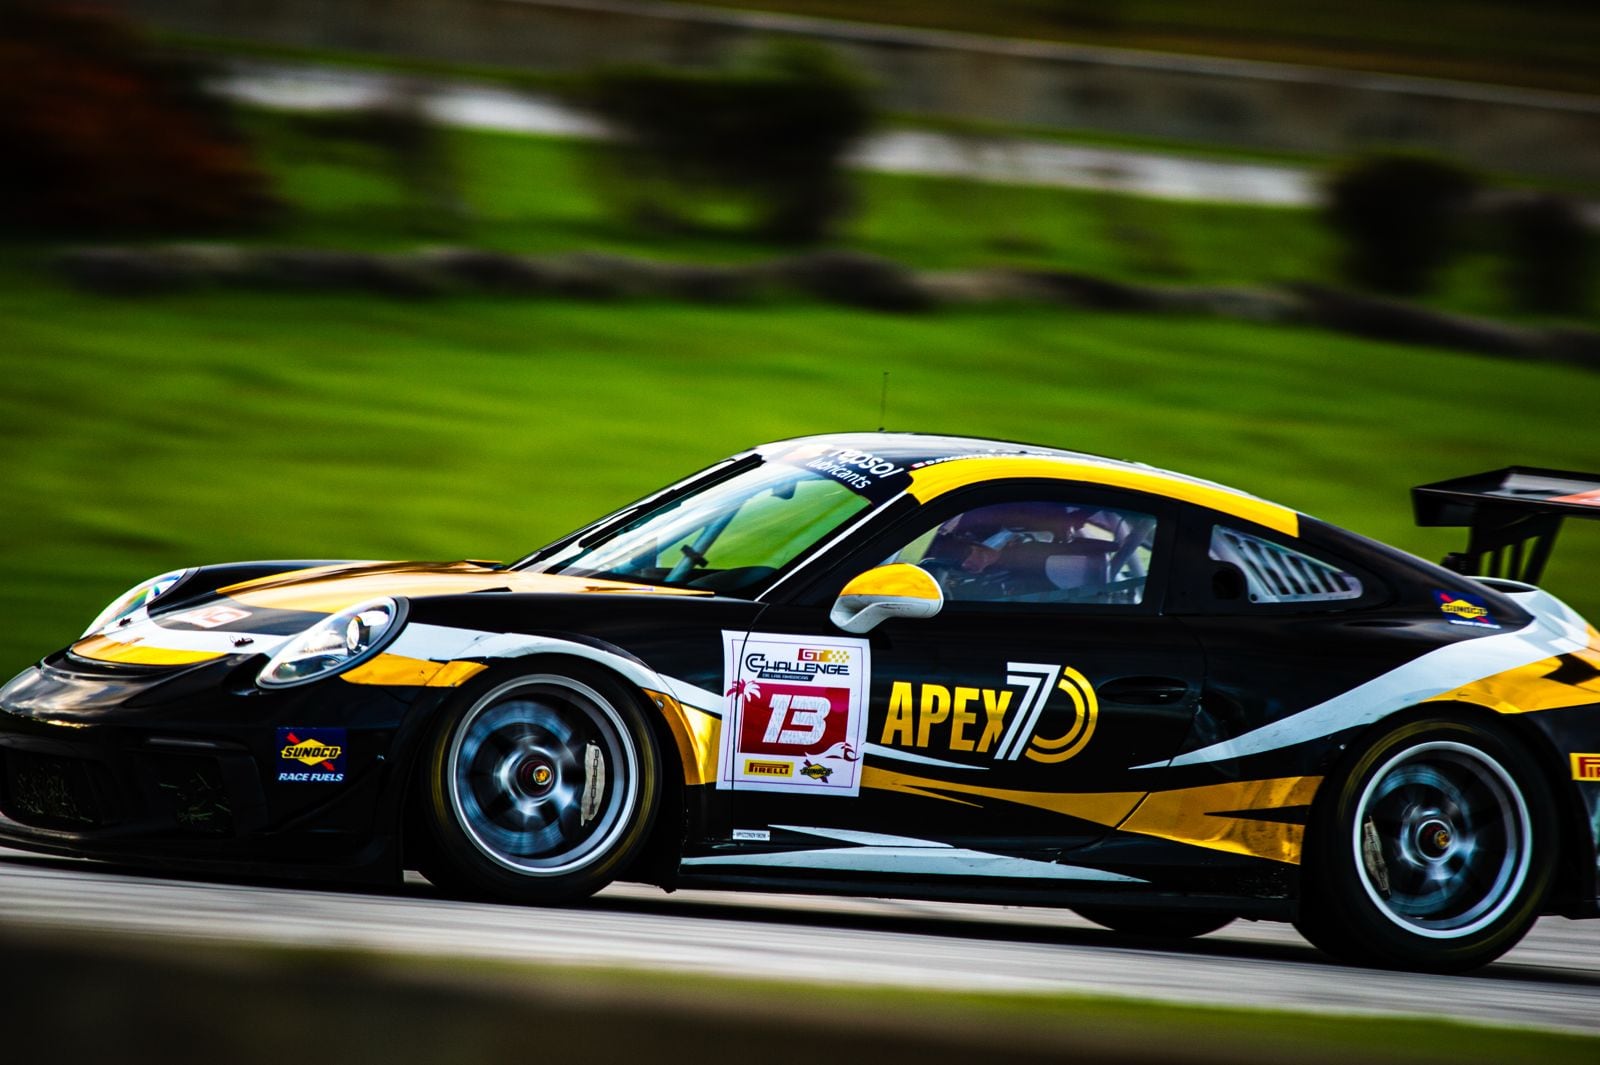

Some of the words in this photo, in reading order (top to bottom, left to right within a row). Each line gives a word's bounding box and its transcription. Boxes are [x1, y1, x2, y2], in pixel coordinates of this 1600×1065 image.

[802, 649, 825, 660] GT
[745, 653, 850, 675] CHALLENGE
[762, 694, 831, 745] 13
[283, 747, 339, 758] SUNOCO
[749, 762, 790, 775] PIRELLI
[279, 773, 310, 781] RACE
[310, 773, 344, 781] FUELS
